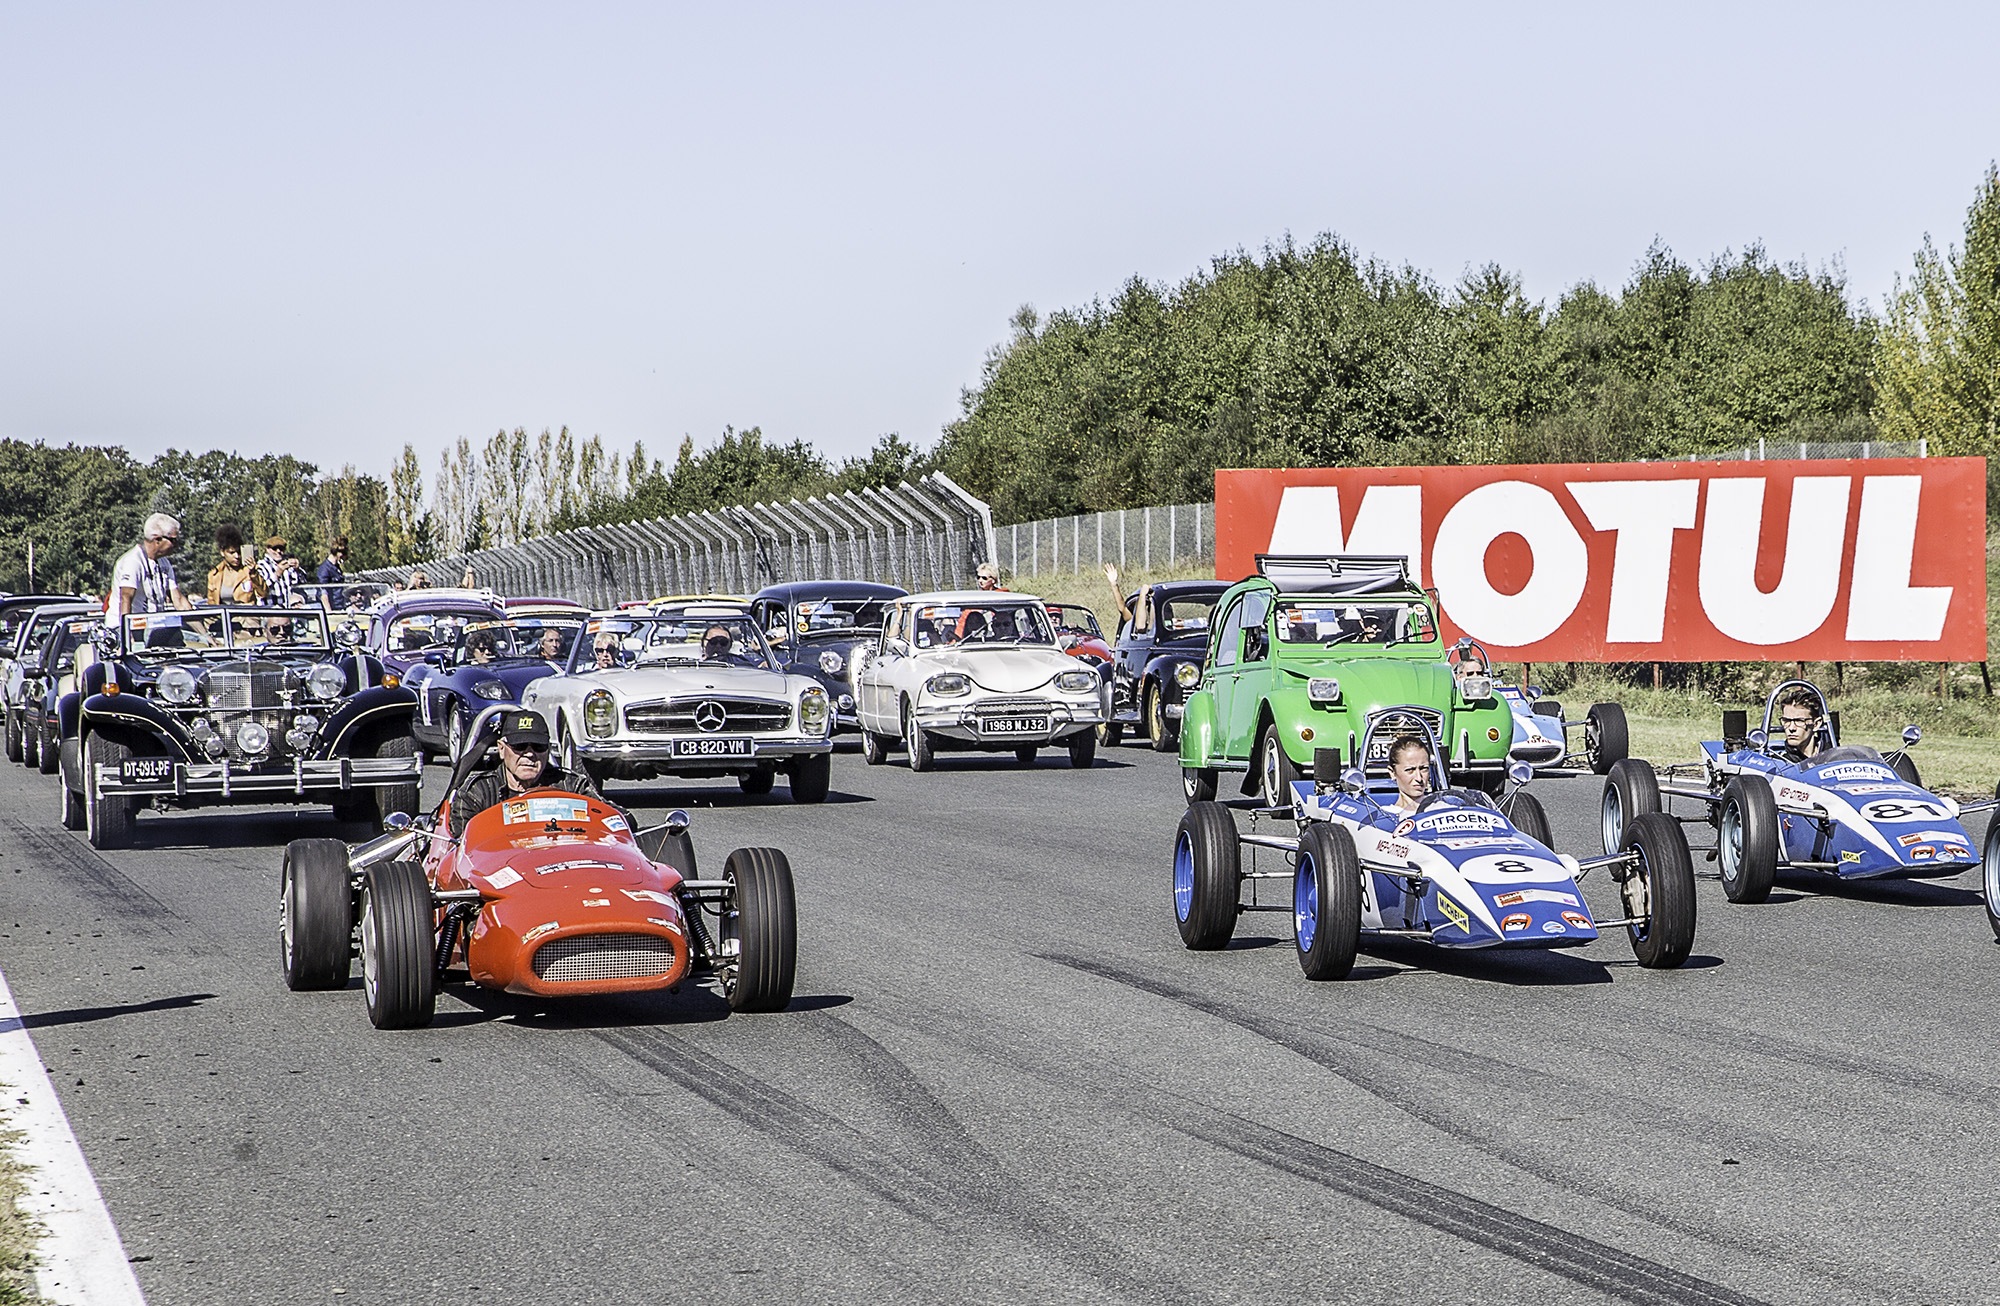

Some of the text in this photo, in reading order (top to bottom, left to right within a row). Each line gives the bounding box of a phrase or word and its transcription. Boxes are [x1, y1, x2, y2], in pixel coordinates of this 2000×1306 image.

[989, 721, 1013, 731] 1968
[1030, 719, 1044, 730] 32
[680, 740, 745, 754] CB-820-VM
[124, 761, 171, 776] DT-091-PF
[1868, 804, 1941, 819] 81
[1421, 812, 1489, 829] CITROËN
[1439, 823, 1491, 832] moteur GS
[1494, 860, 1535, 873] 8
[1439, 896, 1469, 929] MICHELIN
